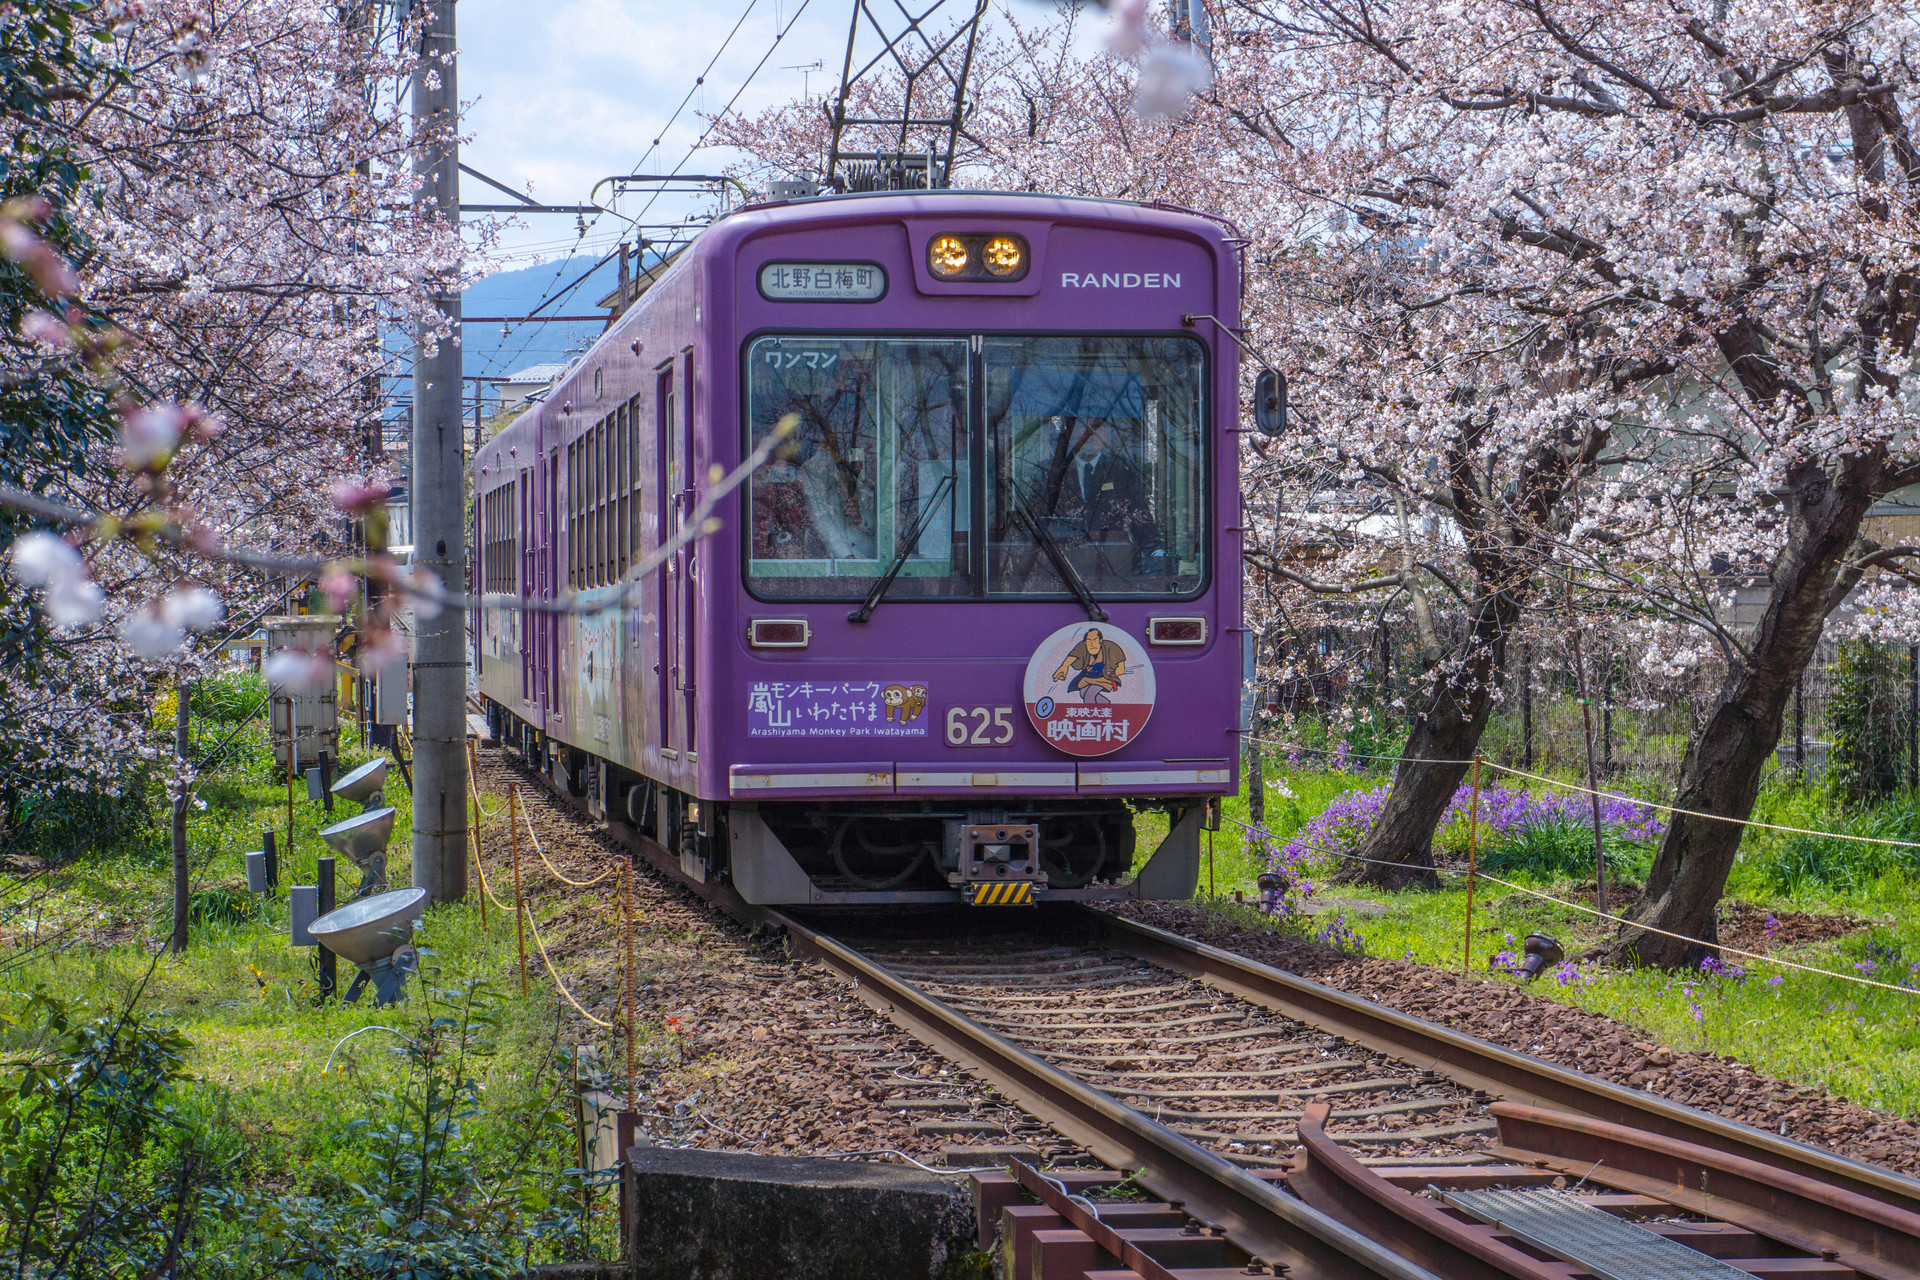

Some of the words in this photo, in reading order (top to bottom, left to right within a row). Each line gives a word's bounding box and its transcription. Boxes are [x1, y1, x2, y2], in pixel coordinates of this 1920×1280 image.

[771, 267, 875, 290] 北野白梅町
[1061, 272, 1181, 288] RANDEN
[765, 351, 838, 369] ワンマン
[770, 681, 880, 699] モンキーパーク
[796, 701, 878, 722] いわたやま
[751, 727, 806, 738] Arashiyama
[809, 727, 847, 737] Monkey
[849, 727, 871, 736] Park
[873, 727, 926, 737] Iwatayama
[946, 706, 1014, 745] 625
[1047, 719, 1131, 742] 映画村
